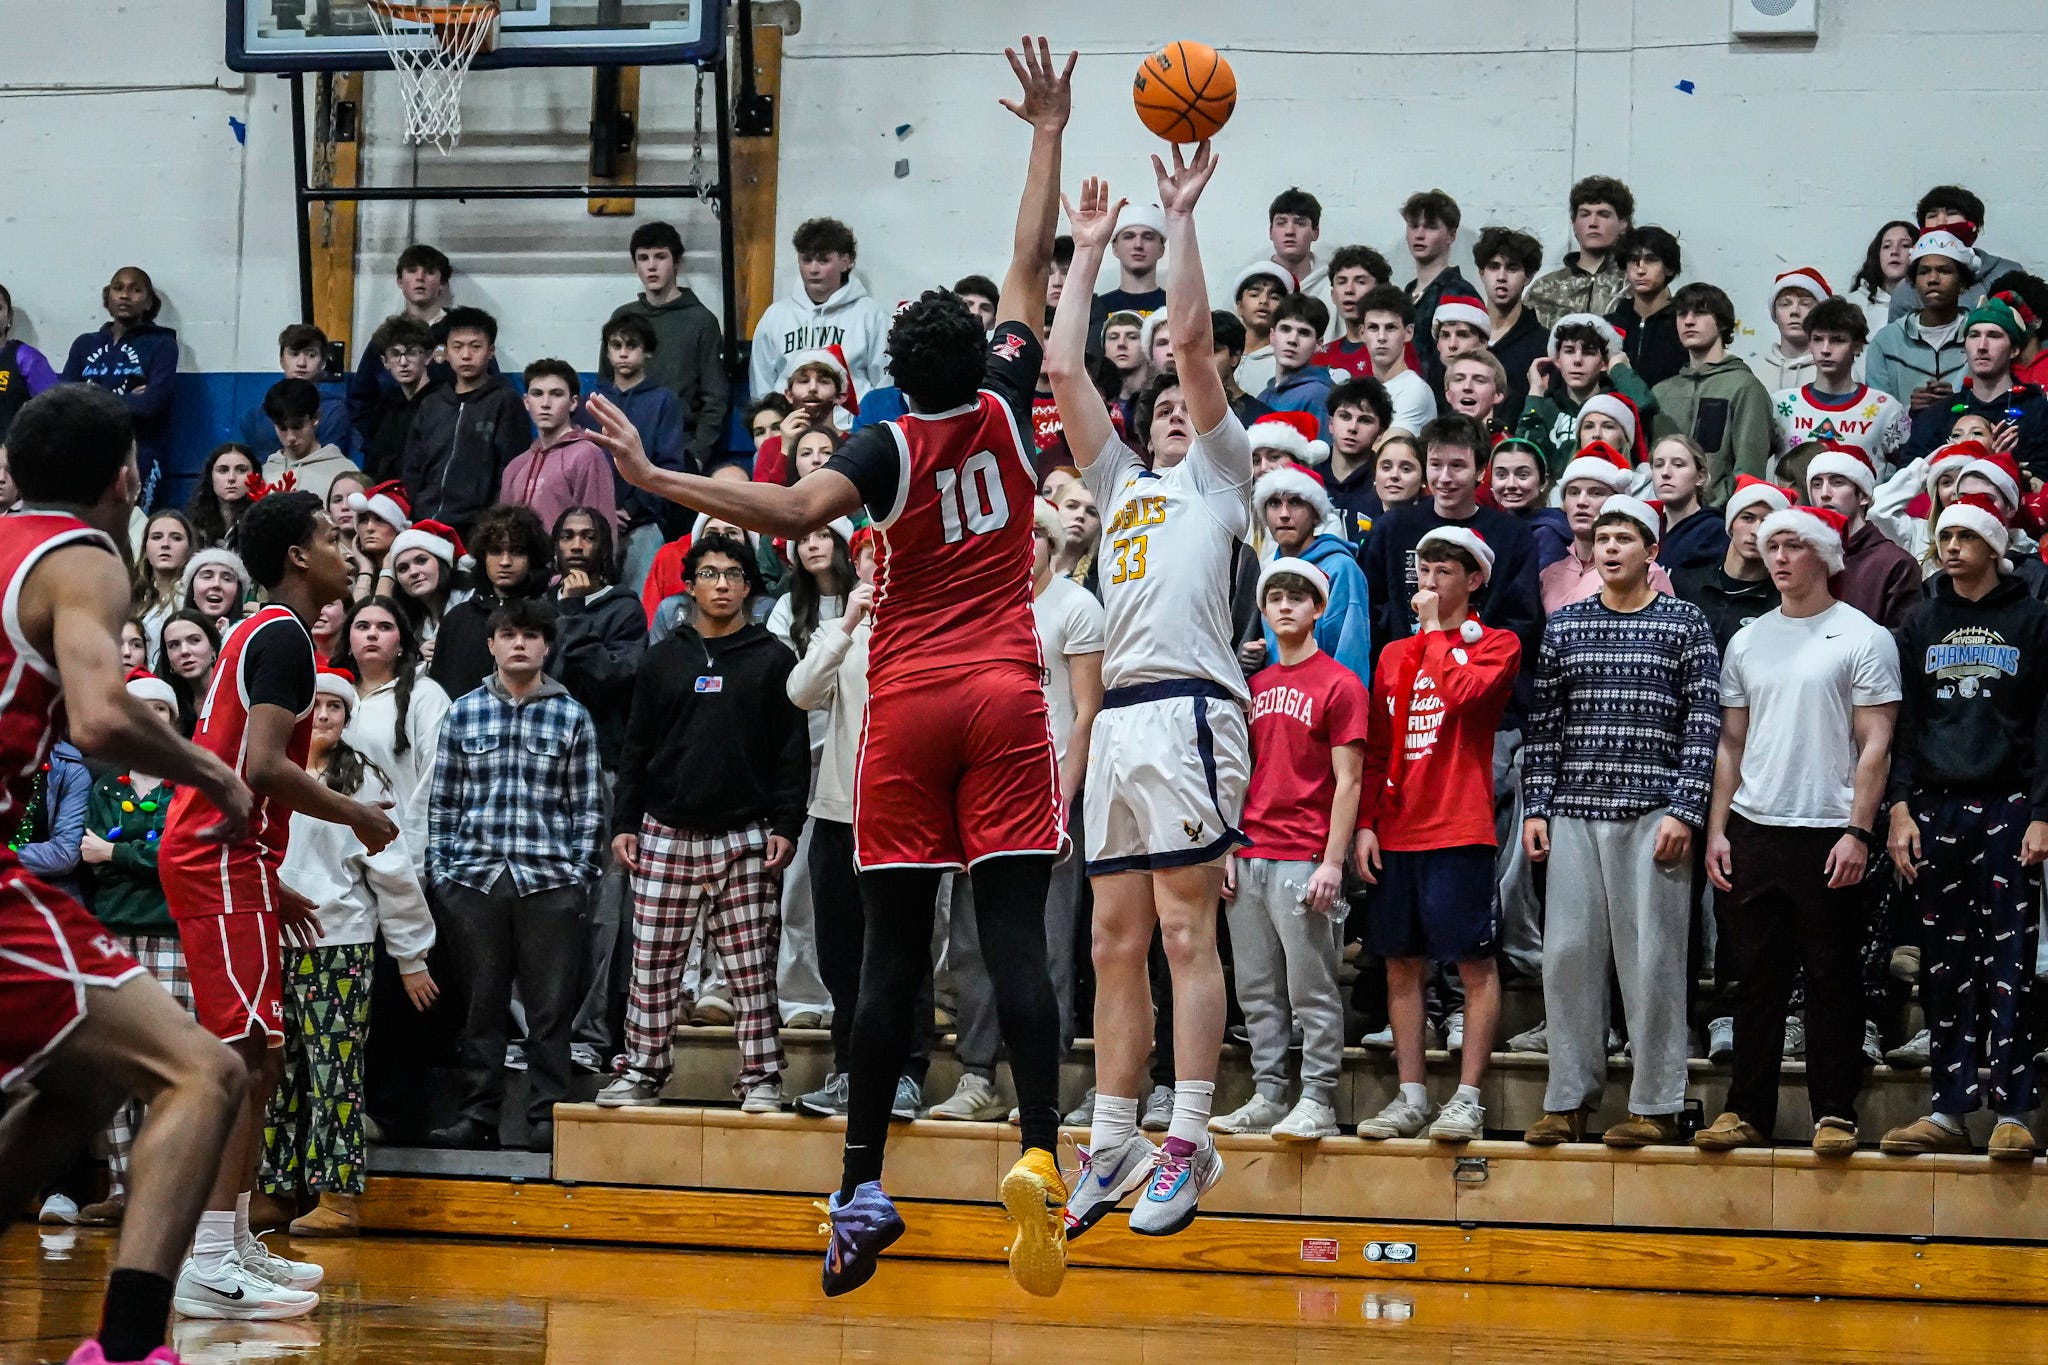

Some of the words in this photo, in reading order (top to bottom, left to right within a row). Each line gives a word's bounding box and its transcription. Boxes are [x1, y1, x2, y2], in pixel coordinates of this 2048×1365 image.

[1795, 416, 1813, 429] IN
[1840, 420, 1873, 435] MY
[935, 449, 1009, 544] 10
[1112, 534, 1149, 585] 33
[1986, 637, 1994, 645] 2
[1925, 645, 2020, 676] CHAMPIONS
[1247, 686, 1314, 728] GEORGIA
[1404, 729, 1438, 749] NIMAL
